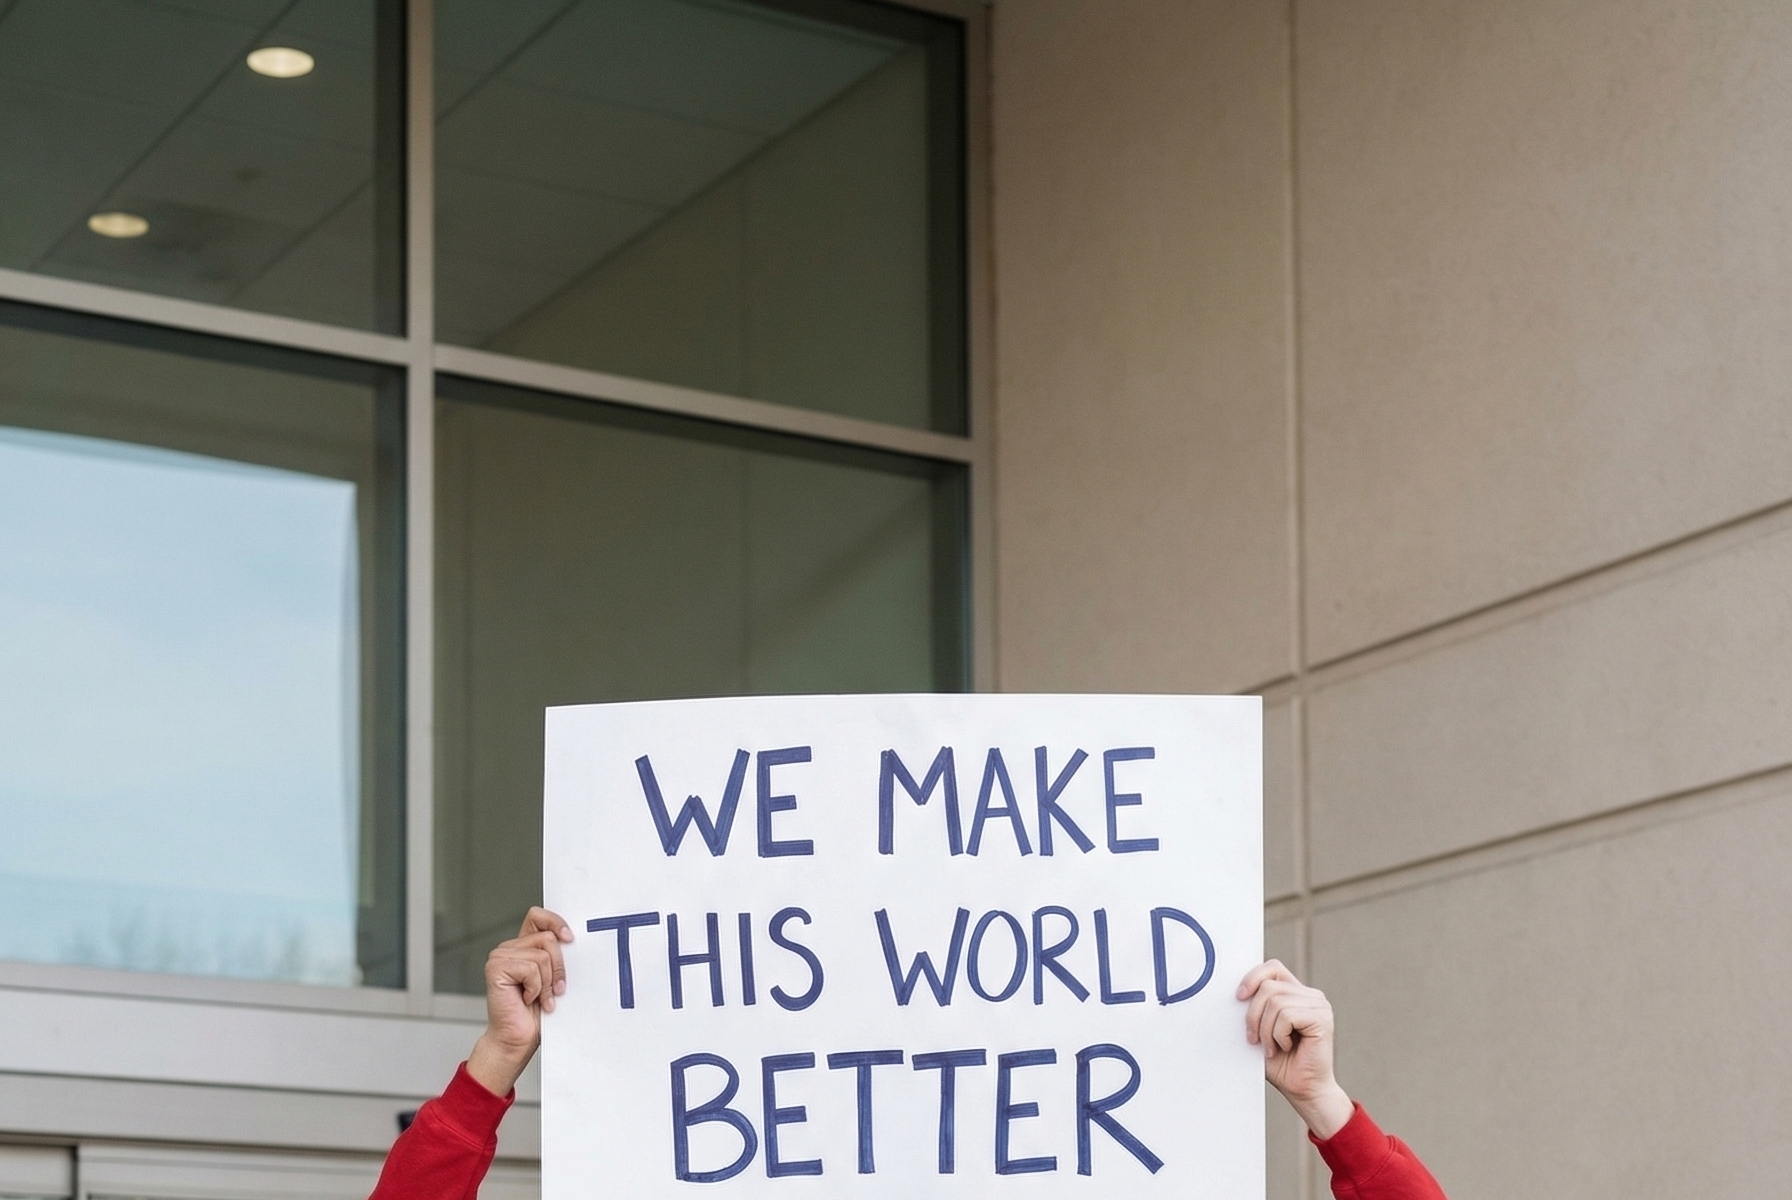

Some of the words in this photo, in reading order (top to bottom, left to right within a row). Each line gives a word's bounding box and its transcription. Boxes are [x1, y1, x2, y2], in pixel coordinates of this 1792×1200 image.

[635, 745, 815, 858] WE
[878, 745, 1160, 857] MAKE
[586, 906, 824, 1012] THIS
[874, 905, 1216, 1007] WORLD
[670, 1043, 1165, 1184] BETTER
